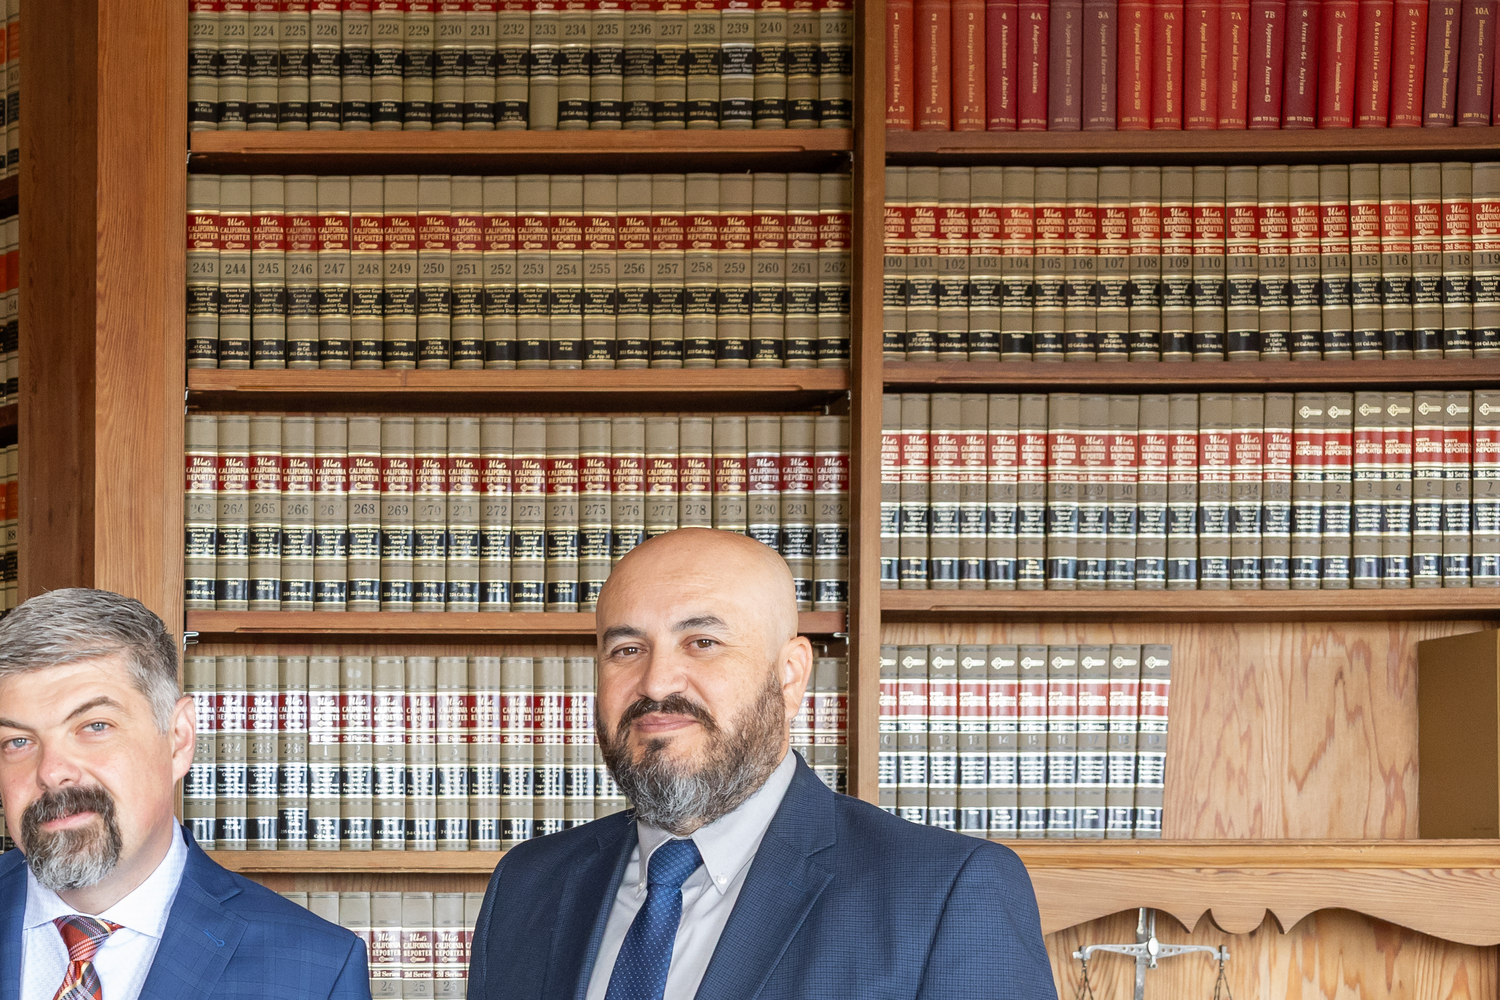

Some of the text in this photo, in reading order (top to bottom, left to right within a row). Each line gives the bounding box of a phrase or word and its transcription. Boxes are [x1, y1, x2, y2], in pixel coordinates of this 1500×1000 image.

[894, 12, 899, 20] 1
[932, 13, 937, 21] 2
[969, 12, 974, 20] 3
[1135, 11, 1140, 19] 6
[1164, 12, 1174, 20] 6A
[1231, 12, 1242, 20] 7A
[193, 24, 214, 35] 222
[253, 25, 274, 36] 224
[285, 25, 306, 36] 225
[348, 24, 369, 36] 227
[378, 24, 399, 35] 228
[440, 25, 462, 36] 230
[471, 25, 491, 36] 231
[535, 24, 556, 35] 233
[565, 24, 586, 36] 234
[630, 24, 651, 35] 236
[661, 24, 683, 36] 237
[727, 23, 749, 34] 239
[760, 22, 782, 33] 240
[826, 22, 847, 34] 242
[1373, 22, 1381, 70] Automobiles
[1407, 64, 1416, 110] Bankruptcy
[1362, 244, 1380, 252] Series
[914, 258, 933, 268] 101
[977, 258, 996, 268] 103
[1010, 258, 1029, 268] 104
[1041, 259, 1061, 269] 105
[1104, 258, 1124, 268] 107
[1138, 258, 1157, 268] 108
[1169, 258, 1188, 268] 109
[1266, 258, 1285, 268] 112
[1297, 257, 1316, 267] 113
[1358, 256, 1378, 266] 115
[1388, 255, 1408, 265] 116
[1450, 255, 1470, 265] 118
[1480, 254, 1500, 264] 119
[193, 263, 214, 274] 243
[258, 263, 279, 274] 245
[292, 264, 312, 274] 246
[358, 264, 379, 274] 248
[390, 263, 411, 274] 249
[423, 263, 445, 273] 250
[456, 264, 477, 274] 251
[490, 264, 512, 274] 252
[556, 264, 577, 275] 254
[589, 263, 610, 274] 255
[658, 263, 679, 274] 257
[692, 262, 713, 273] 258
[757, 263, 779, 273] 260
[791, 263, 812, 274] 261
[824, 262, 846, 273] 262
[1336, 484, 1341, 494] 2
[1396, 481, 1401, 492] 4
[1456, 481, 1461, 492] 6
[1488, 482, 1493, 492] 7
[255, 503, 275, 513] 265
[288, 504, 308, 515] 266
[354, 504, 375, 514] 268
[388, 505, 408, 515] 269
[520, 506, 540, 516] 273
[585, 505, 606, 515] 275
[618, 505, 639, 516] 276
[686, 505, 706, 515] 278
[788, 504, 808, 514] 281
[8, 530, 16, 540] 88
